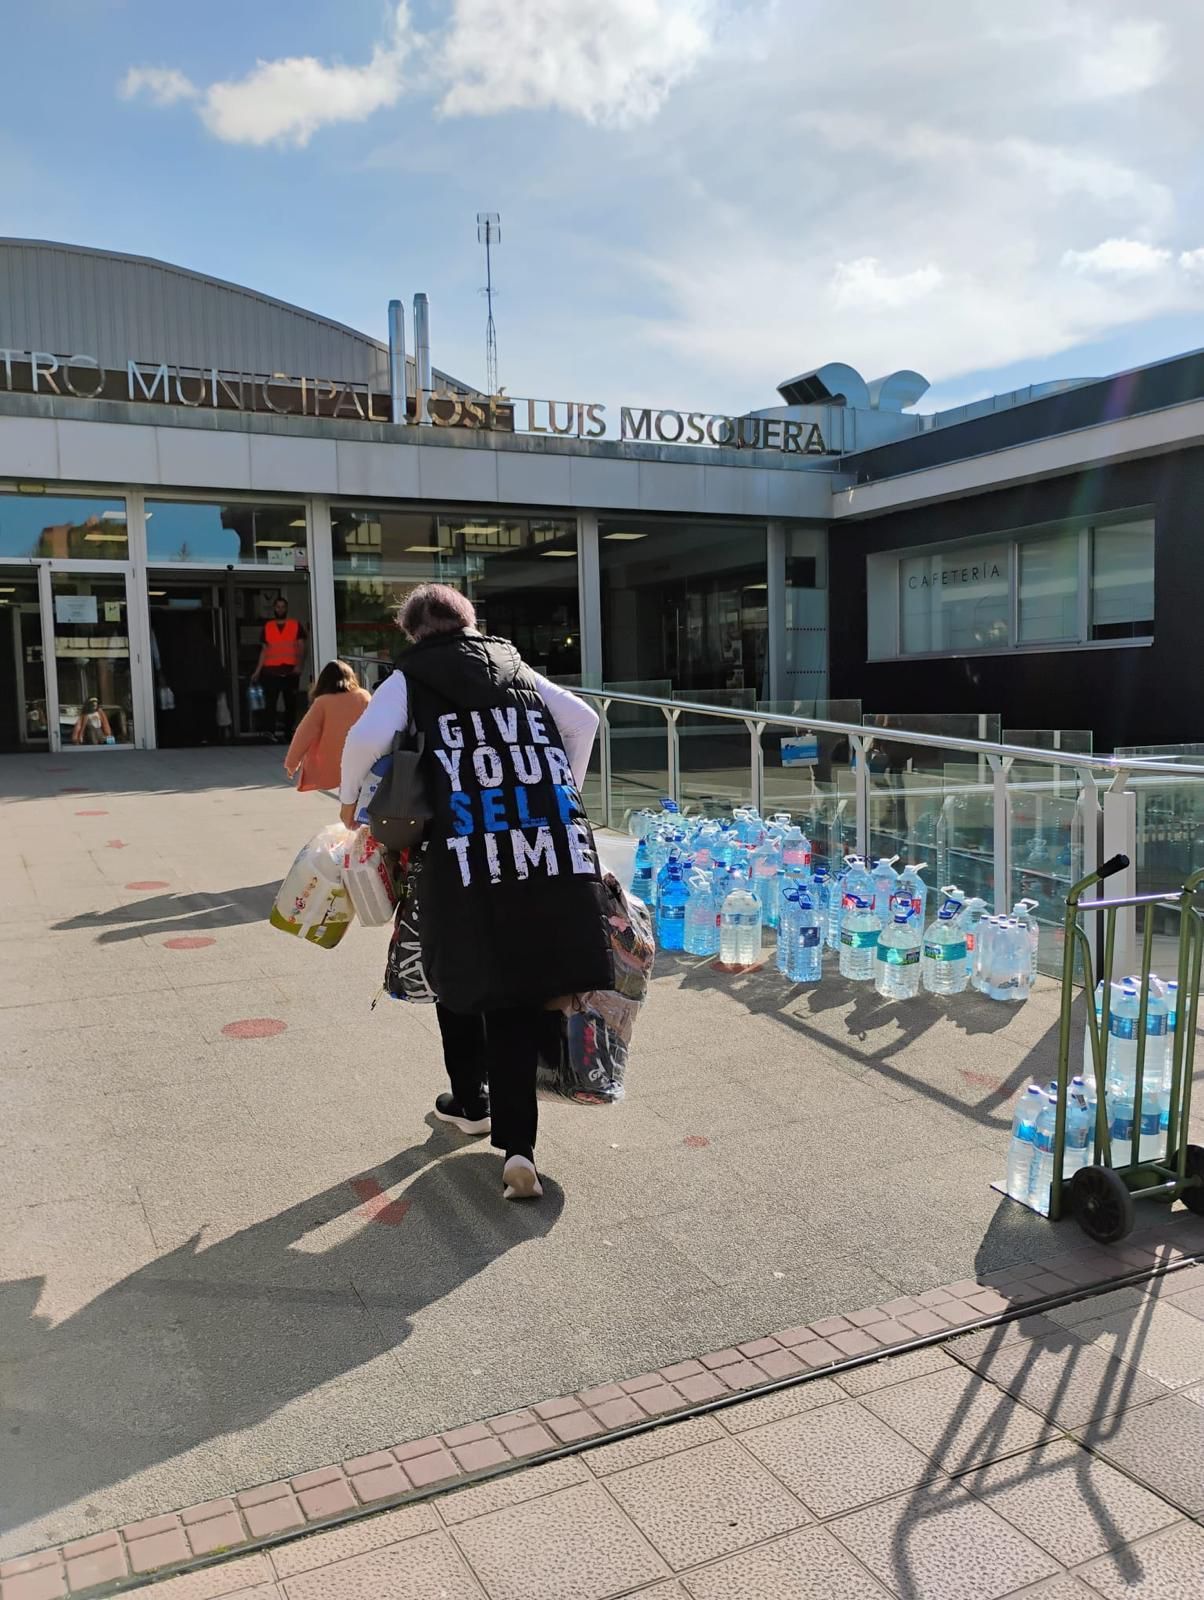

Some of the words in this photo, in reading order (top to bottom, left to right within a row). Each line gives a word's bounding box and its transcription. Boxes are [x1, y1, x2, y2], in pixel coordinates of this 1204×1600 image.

[127, 360, 389, 422] MUNICIPAL
[403, 387, 511, 431] JOSÉ
[528, 399, 607, 439] LUIS
[621, 406, 827, 455] MOSQUERA
[908, 561, 1000, 590] CAFETERÍA
[437, 706, 550, 749] GIVE
[433, 744, 576, 792] YOUR
[449, 783, 582, 837] SELF
[446, 819, 598, 888] TIME
